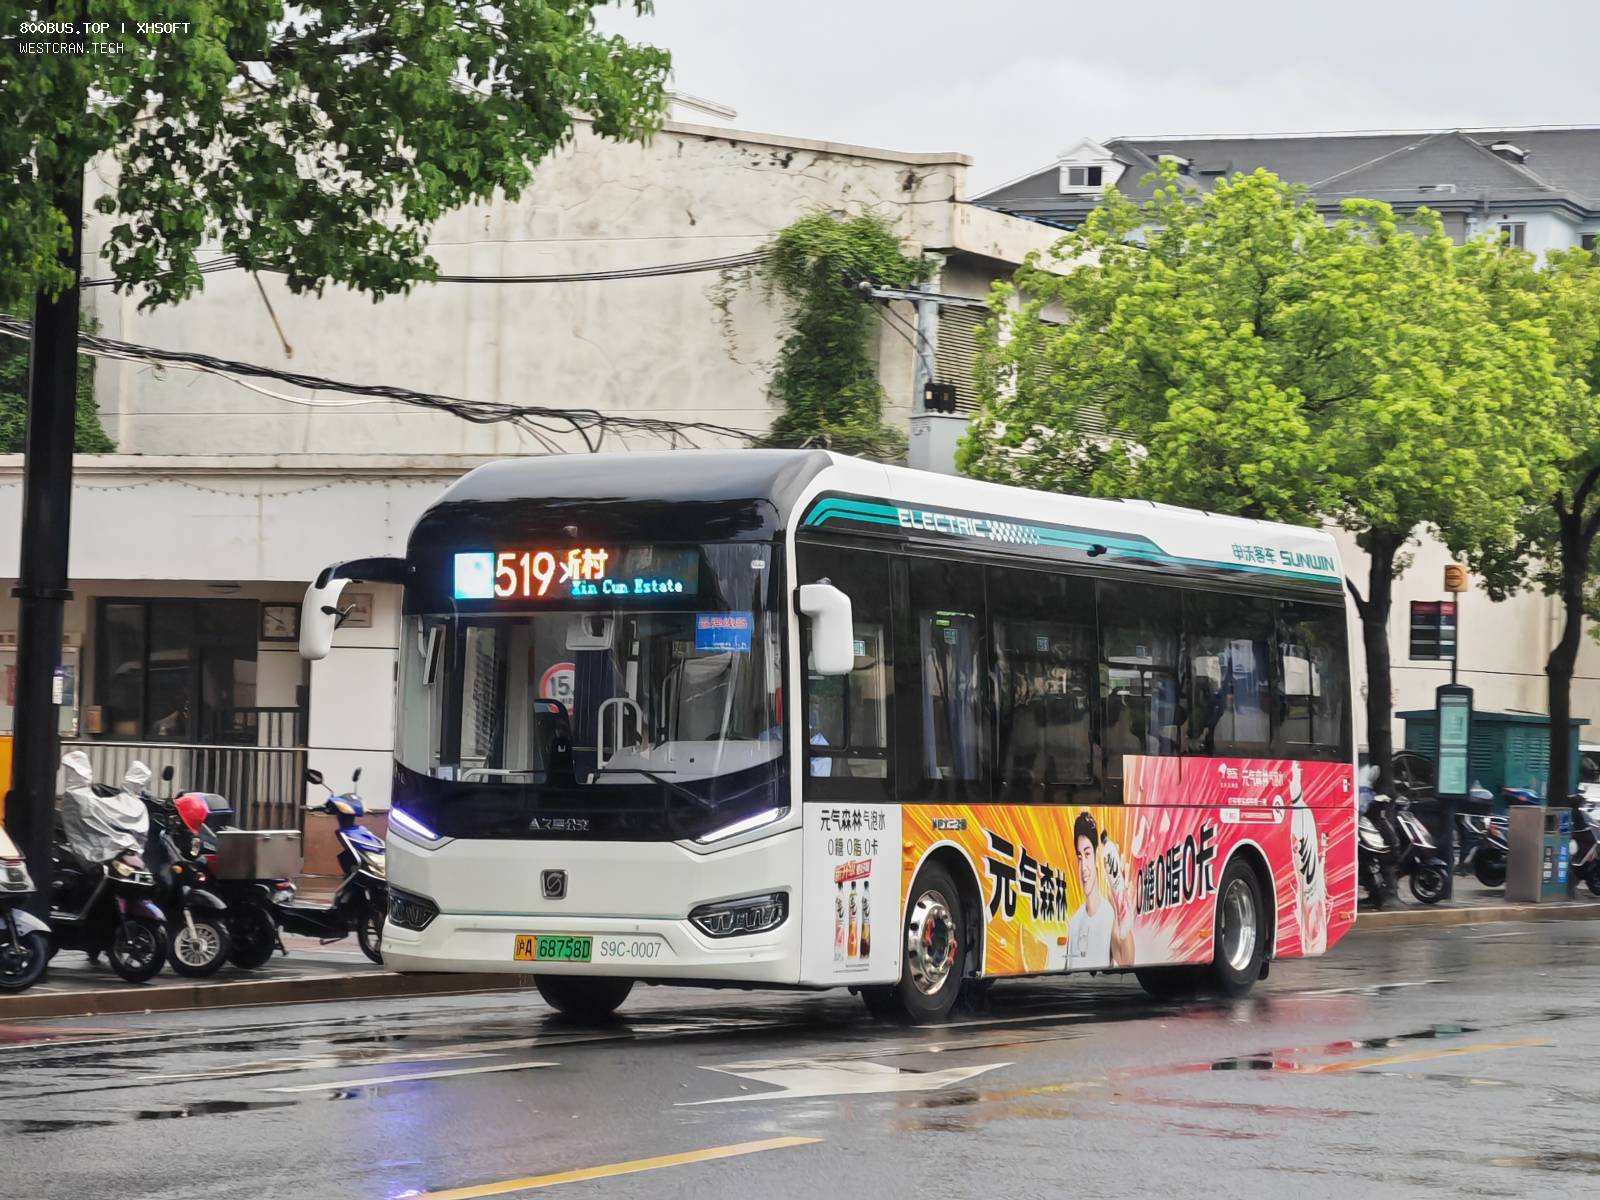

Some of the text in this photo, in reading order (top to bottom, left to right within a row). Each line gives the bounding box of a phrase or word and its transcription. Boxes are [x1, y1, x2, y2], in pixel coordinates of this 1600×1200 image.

[897, 508, 986, 538] ELECTRIC
[1232, 542, 1335, 572] 申沃客车 SUNWIN
[494, 551, 556, 597] 519
[571, 580, 598, 596] Xin
[634, 578, 683, 594] Estate
[550, 675, 571, 697] 15
[820, 808, 886, 831] 元气森林气泡水
[985, 830, 1068, 921] 元气森林
[539, 939, 592, 959] 68758D
[600, 941, 662, 959] S9C-0007
